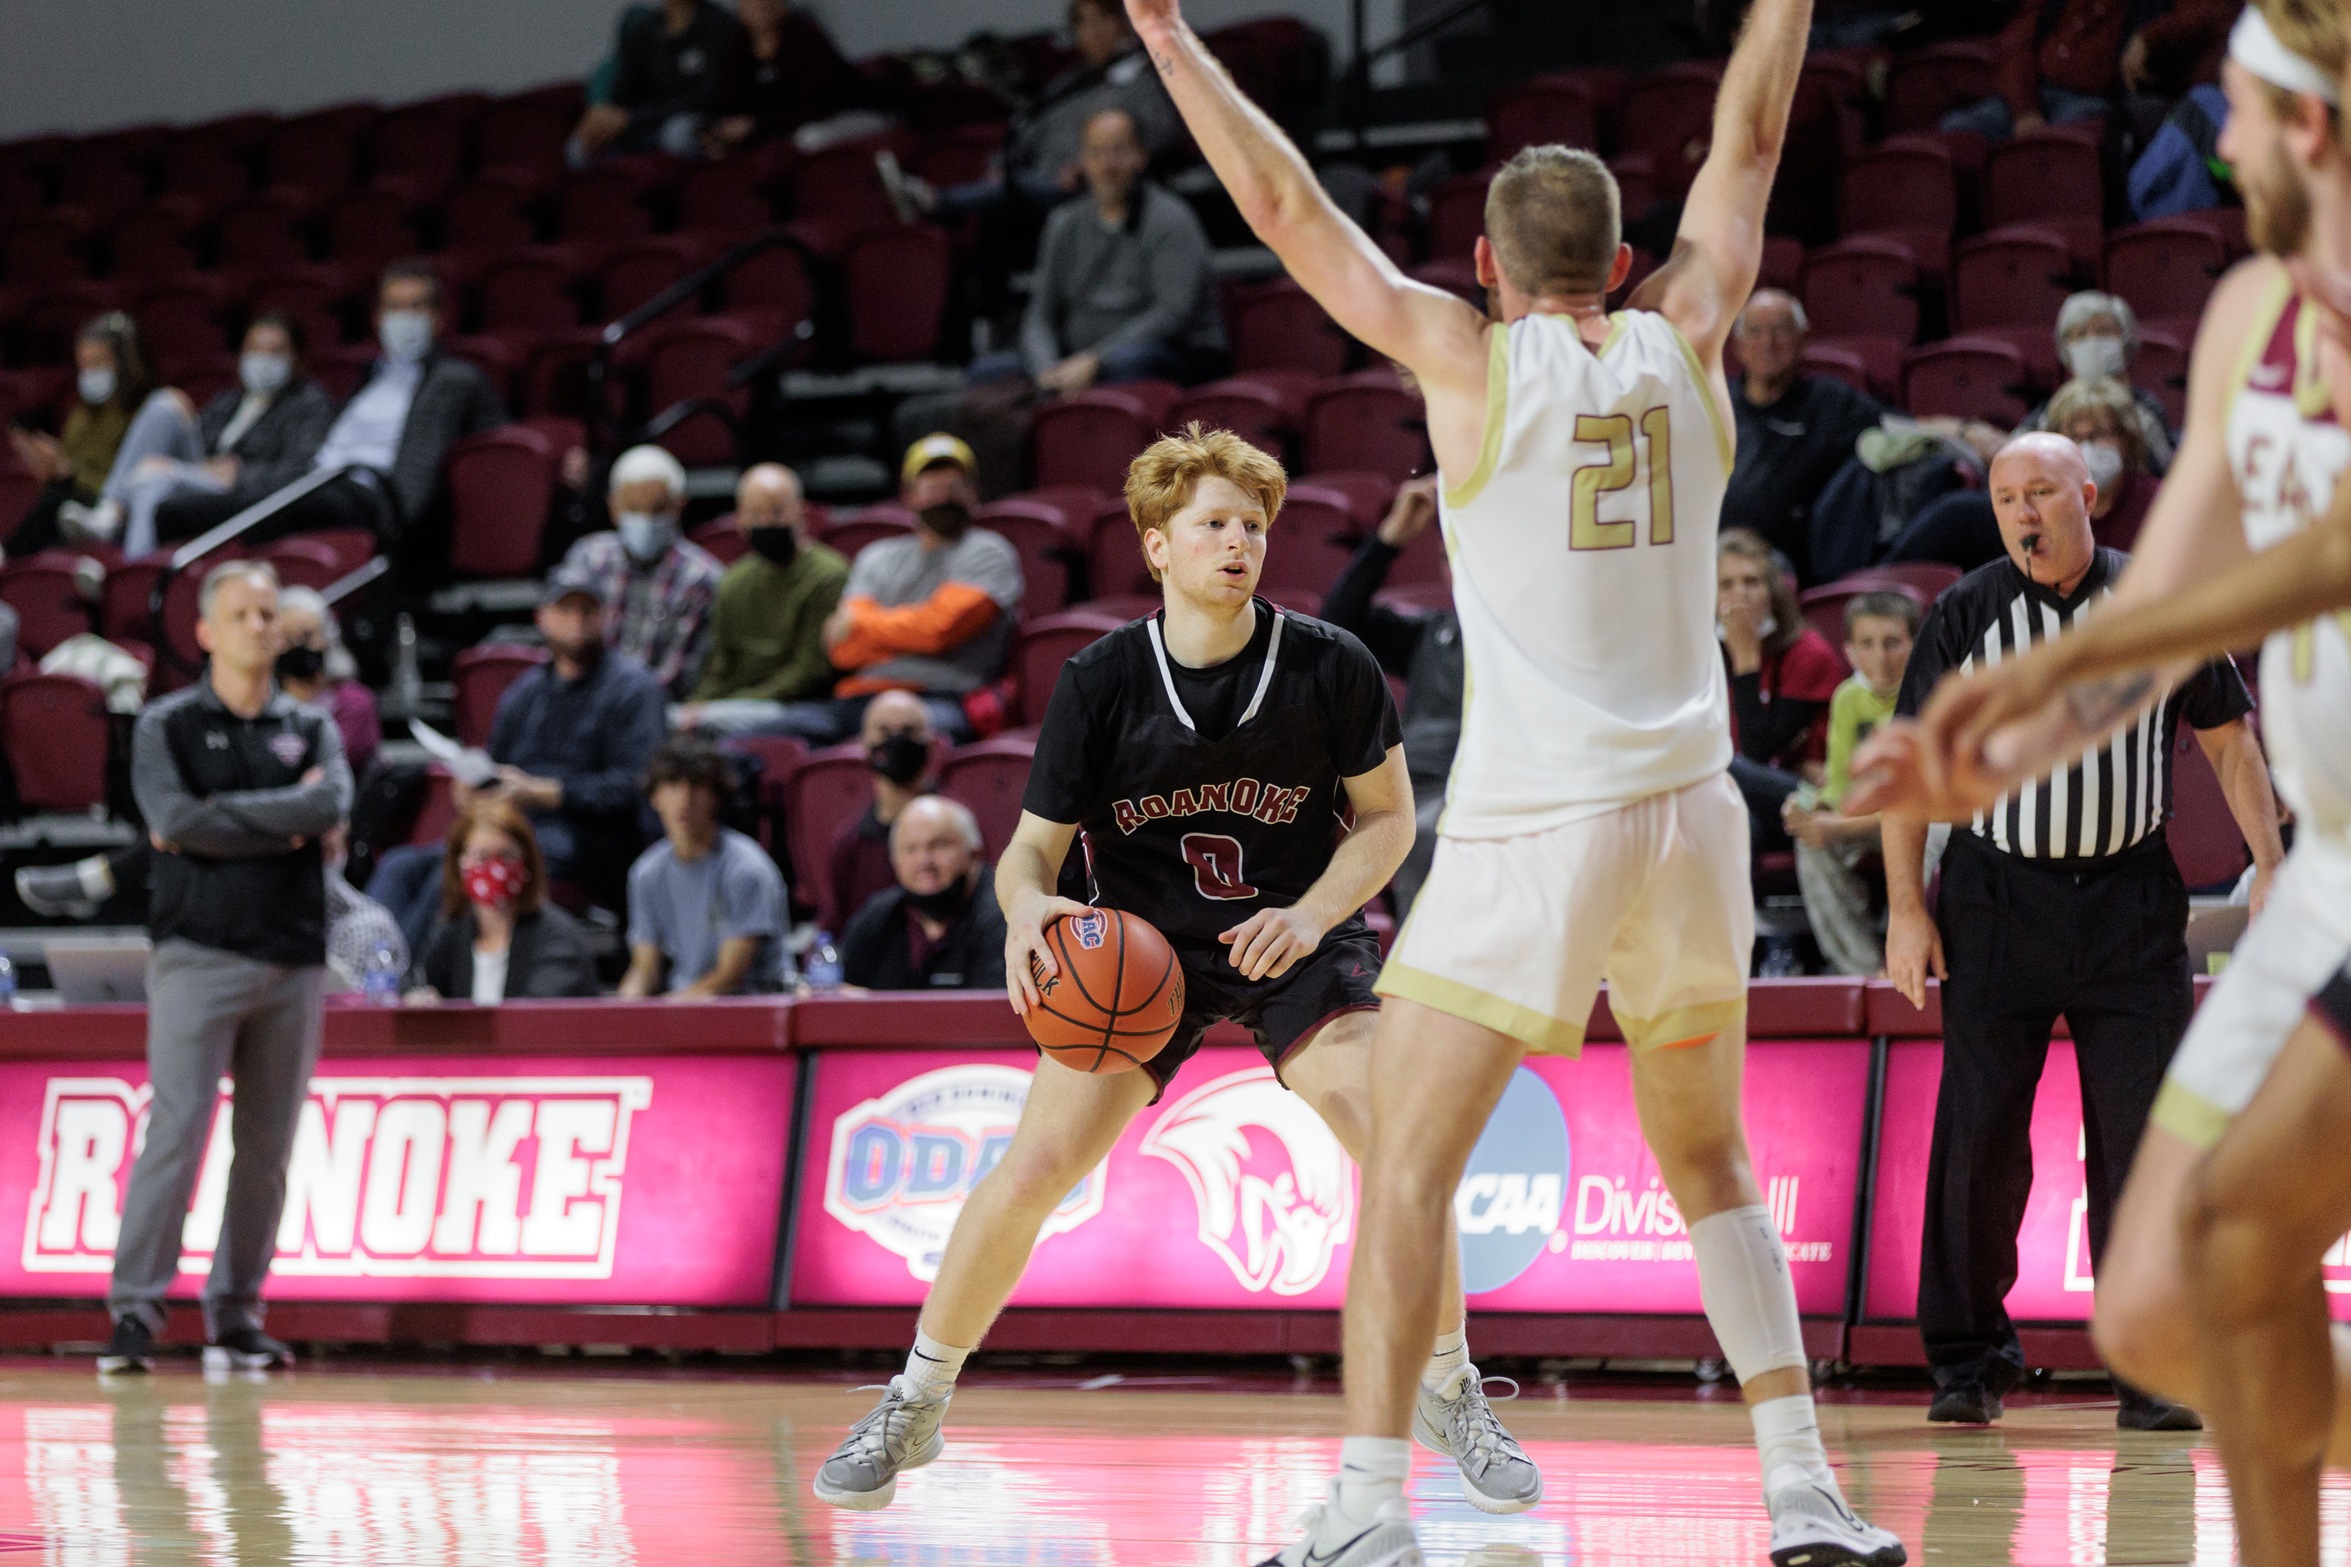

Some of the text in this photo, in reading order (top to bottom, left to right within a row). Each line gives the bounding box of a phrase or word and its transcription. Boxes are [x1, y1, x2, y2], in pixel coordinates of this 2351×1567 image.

[1568, 404, 1675, 551] 21
[1111, 777, 1311, 836] ROANOKE
[1180, 832, 1259, 901] 0
[36, 1094, 622, 1260] RNOKE
[1455, 1173, 1561, 1235] CAA
[1574, 1175, 1690, 1236] Divis
